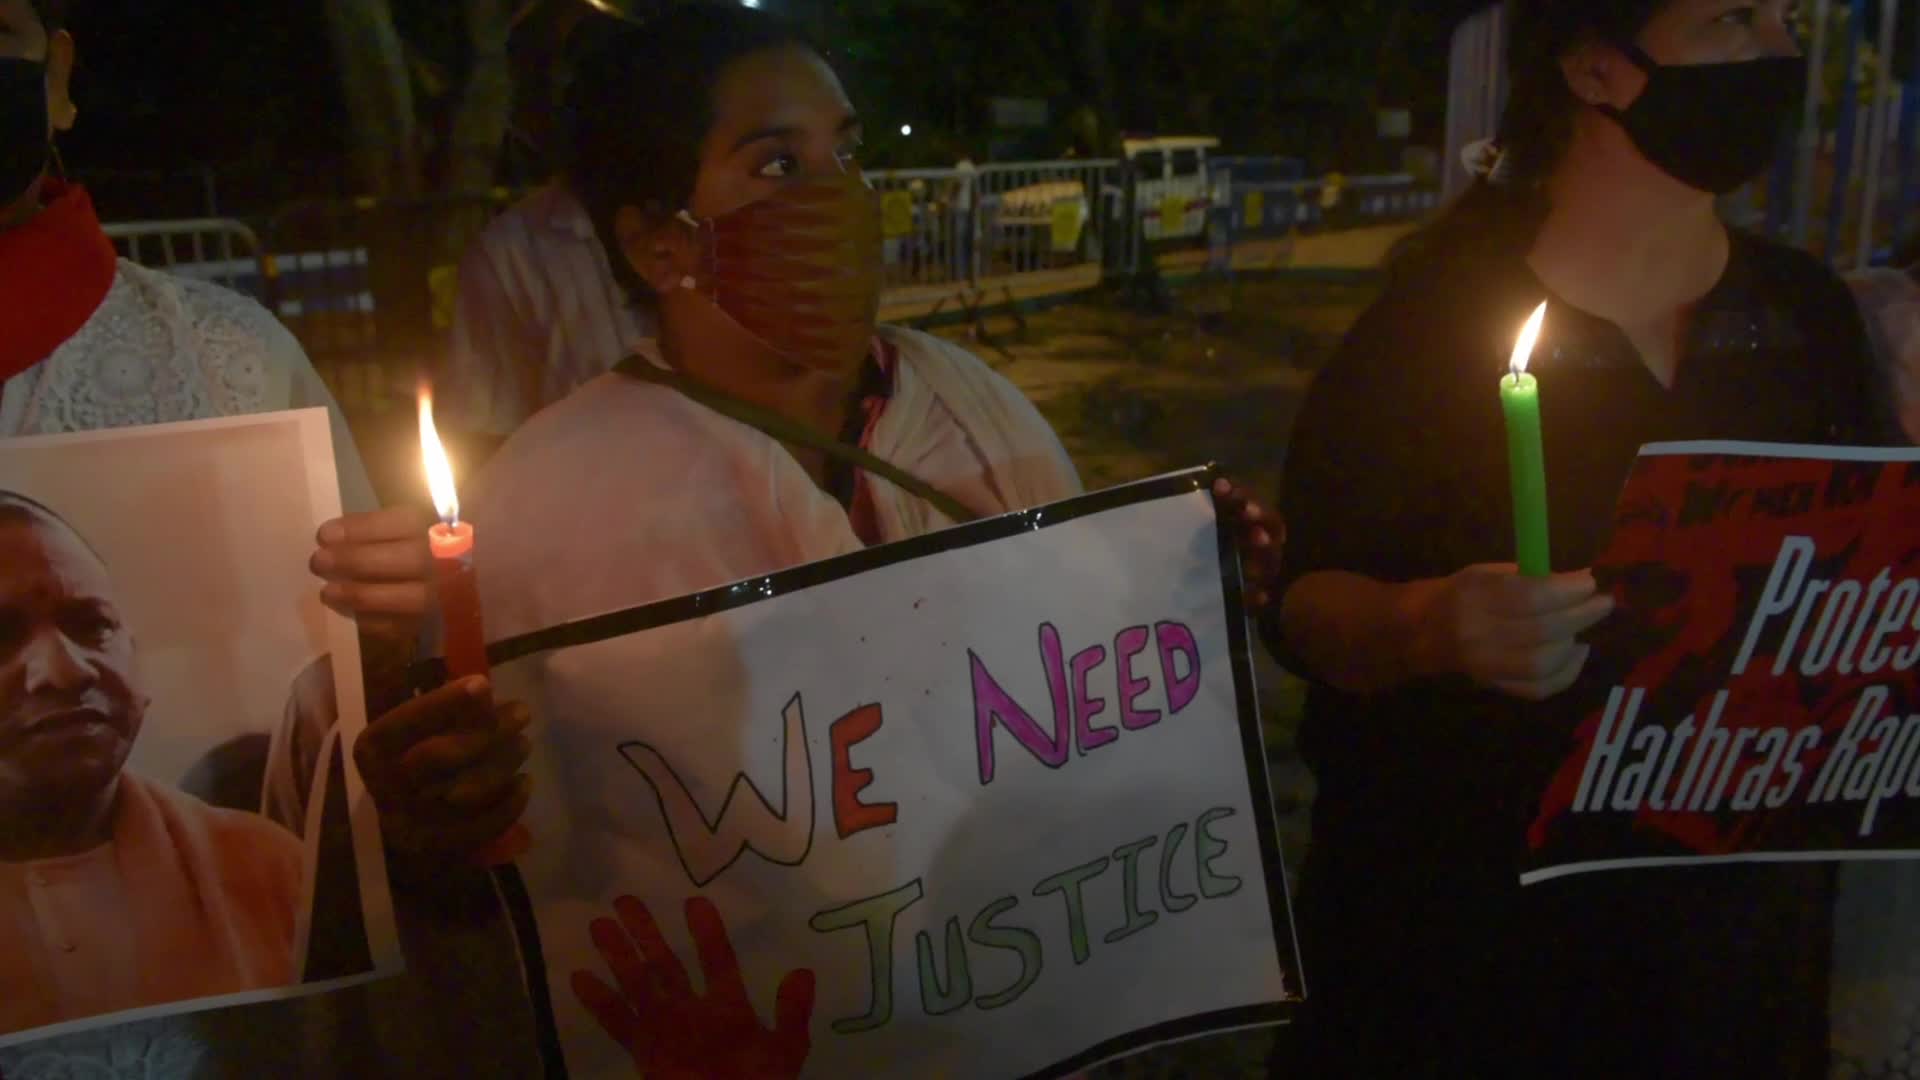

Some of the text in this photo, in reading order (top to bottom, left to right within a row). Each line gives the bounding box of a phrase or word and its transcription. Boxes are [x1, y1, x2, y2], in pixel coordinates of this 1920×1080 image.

[617, 621, 1202, 888] WE NEED
[1571, 684, 1920, 837] Hathras Rap
[808, 806, 1243, 1034] JUSTICE
